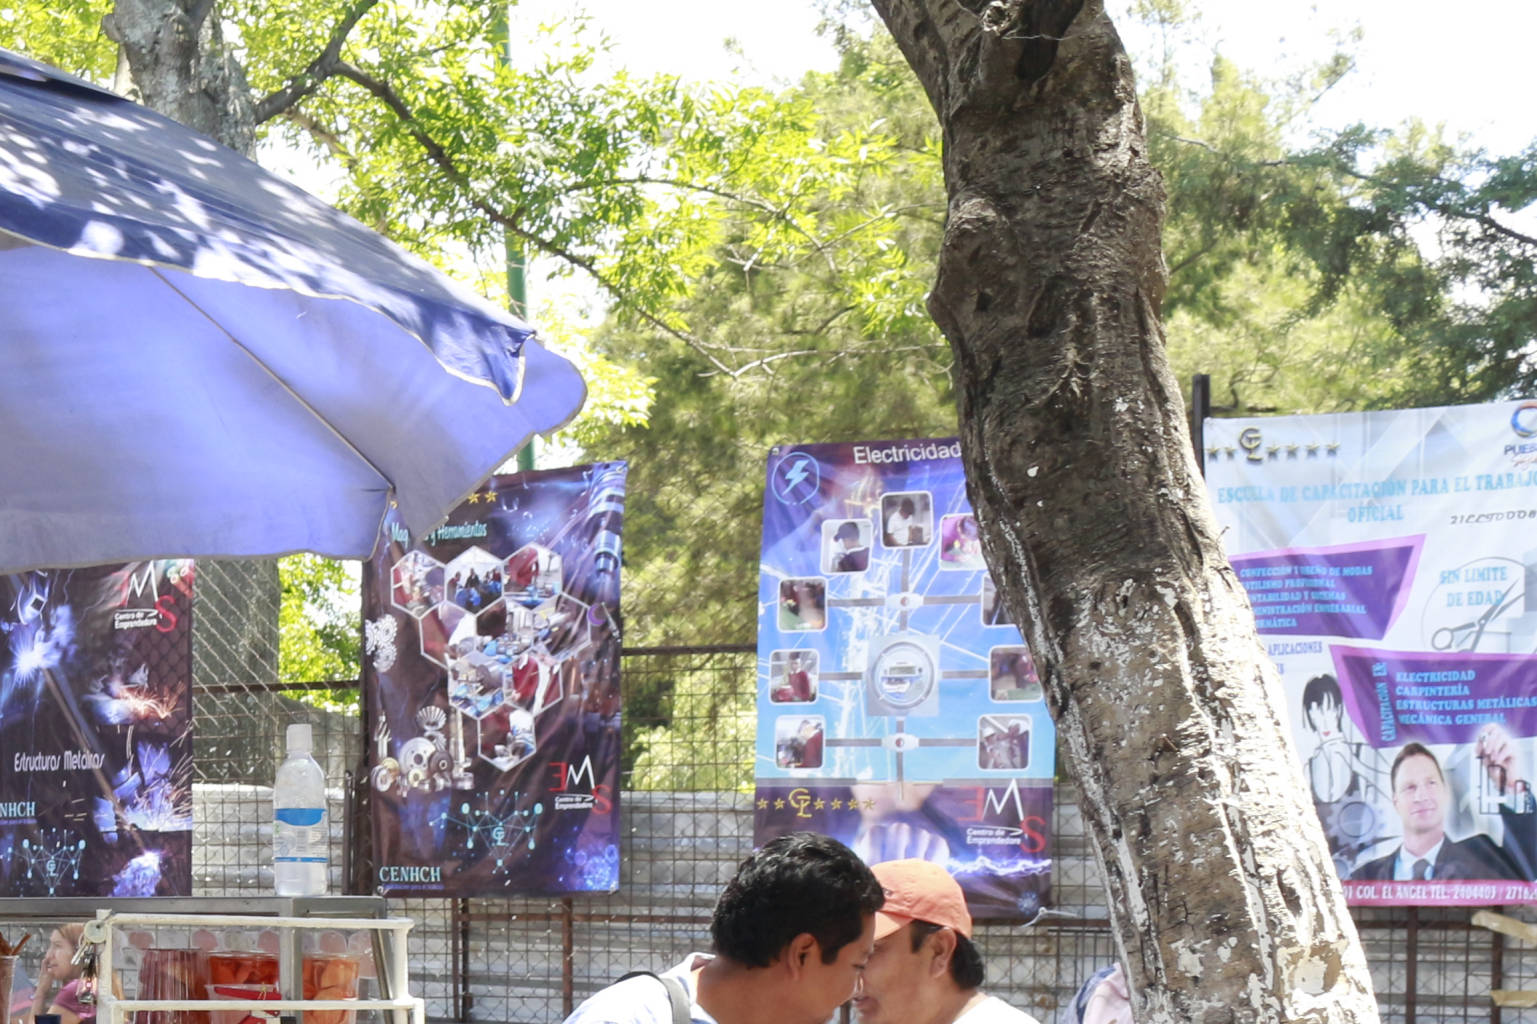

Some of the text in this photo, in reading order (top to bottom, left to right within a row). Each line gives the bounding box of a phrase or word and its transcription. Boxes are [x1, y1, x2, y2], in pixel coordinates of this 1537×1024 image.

[852, 441, 962, 464] Electricidad
[1411, 477, 1449, 496] PARA
[1454, 475, 1472, 492] EL
[1348, 504, 1404, 523] OFICIAL
[1395, 670, 1476, 682] ELECTRICIDAD
[1395, 699, 1475, 711] ESTRUCTURAS
[379, 866, 441, 883] CENHCH
